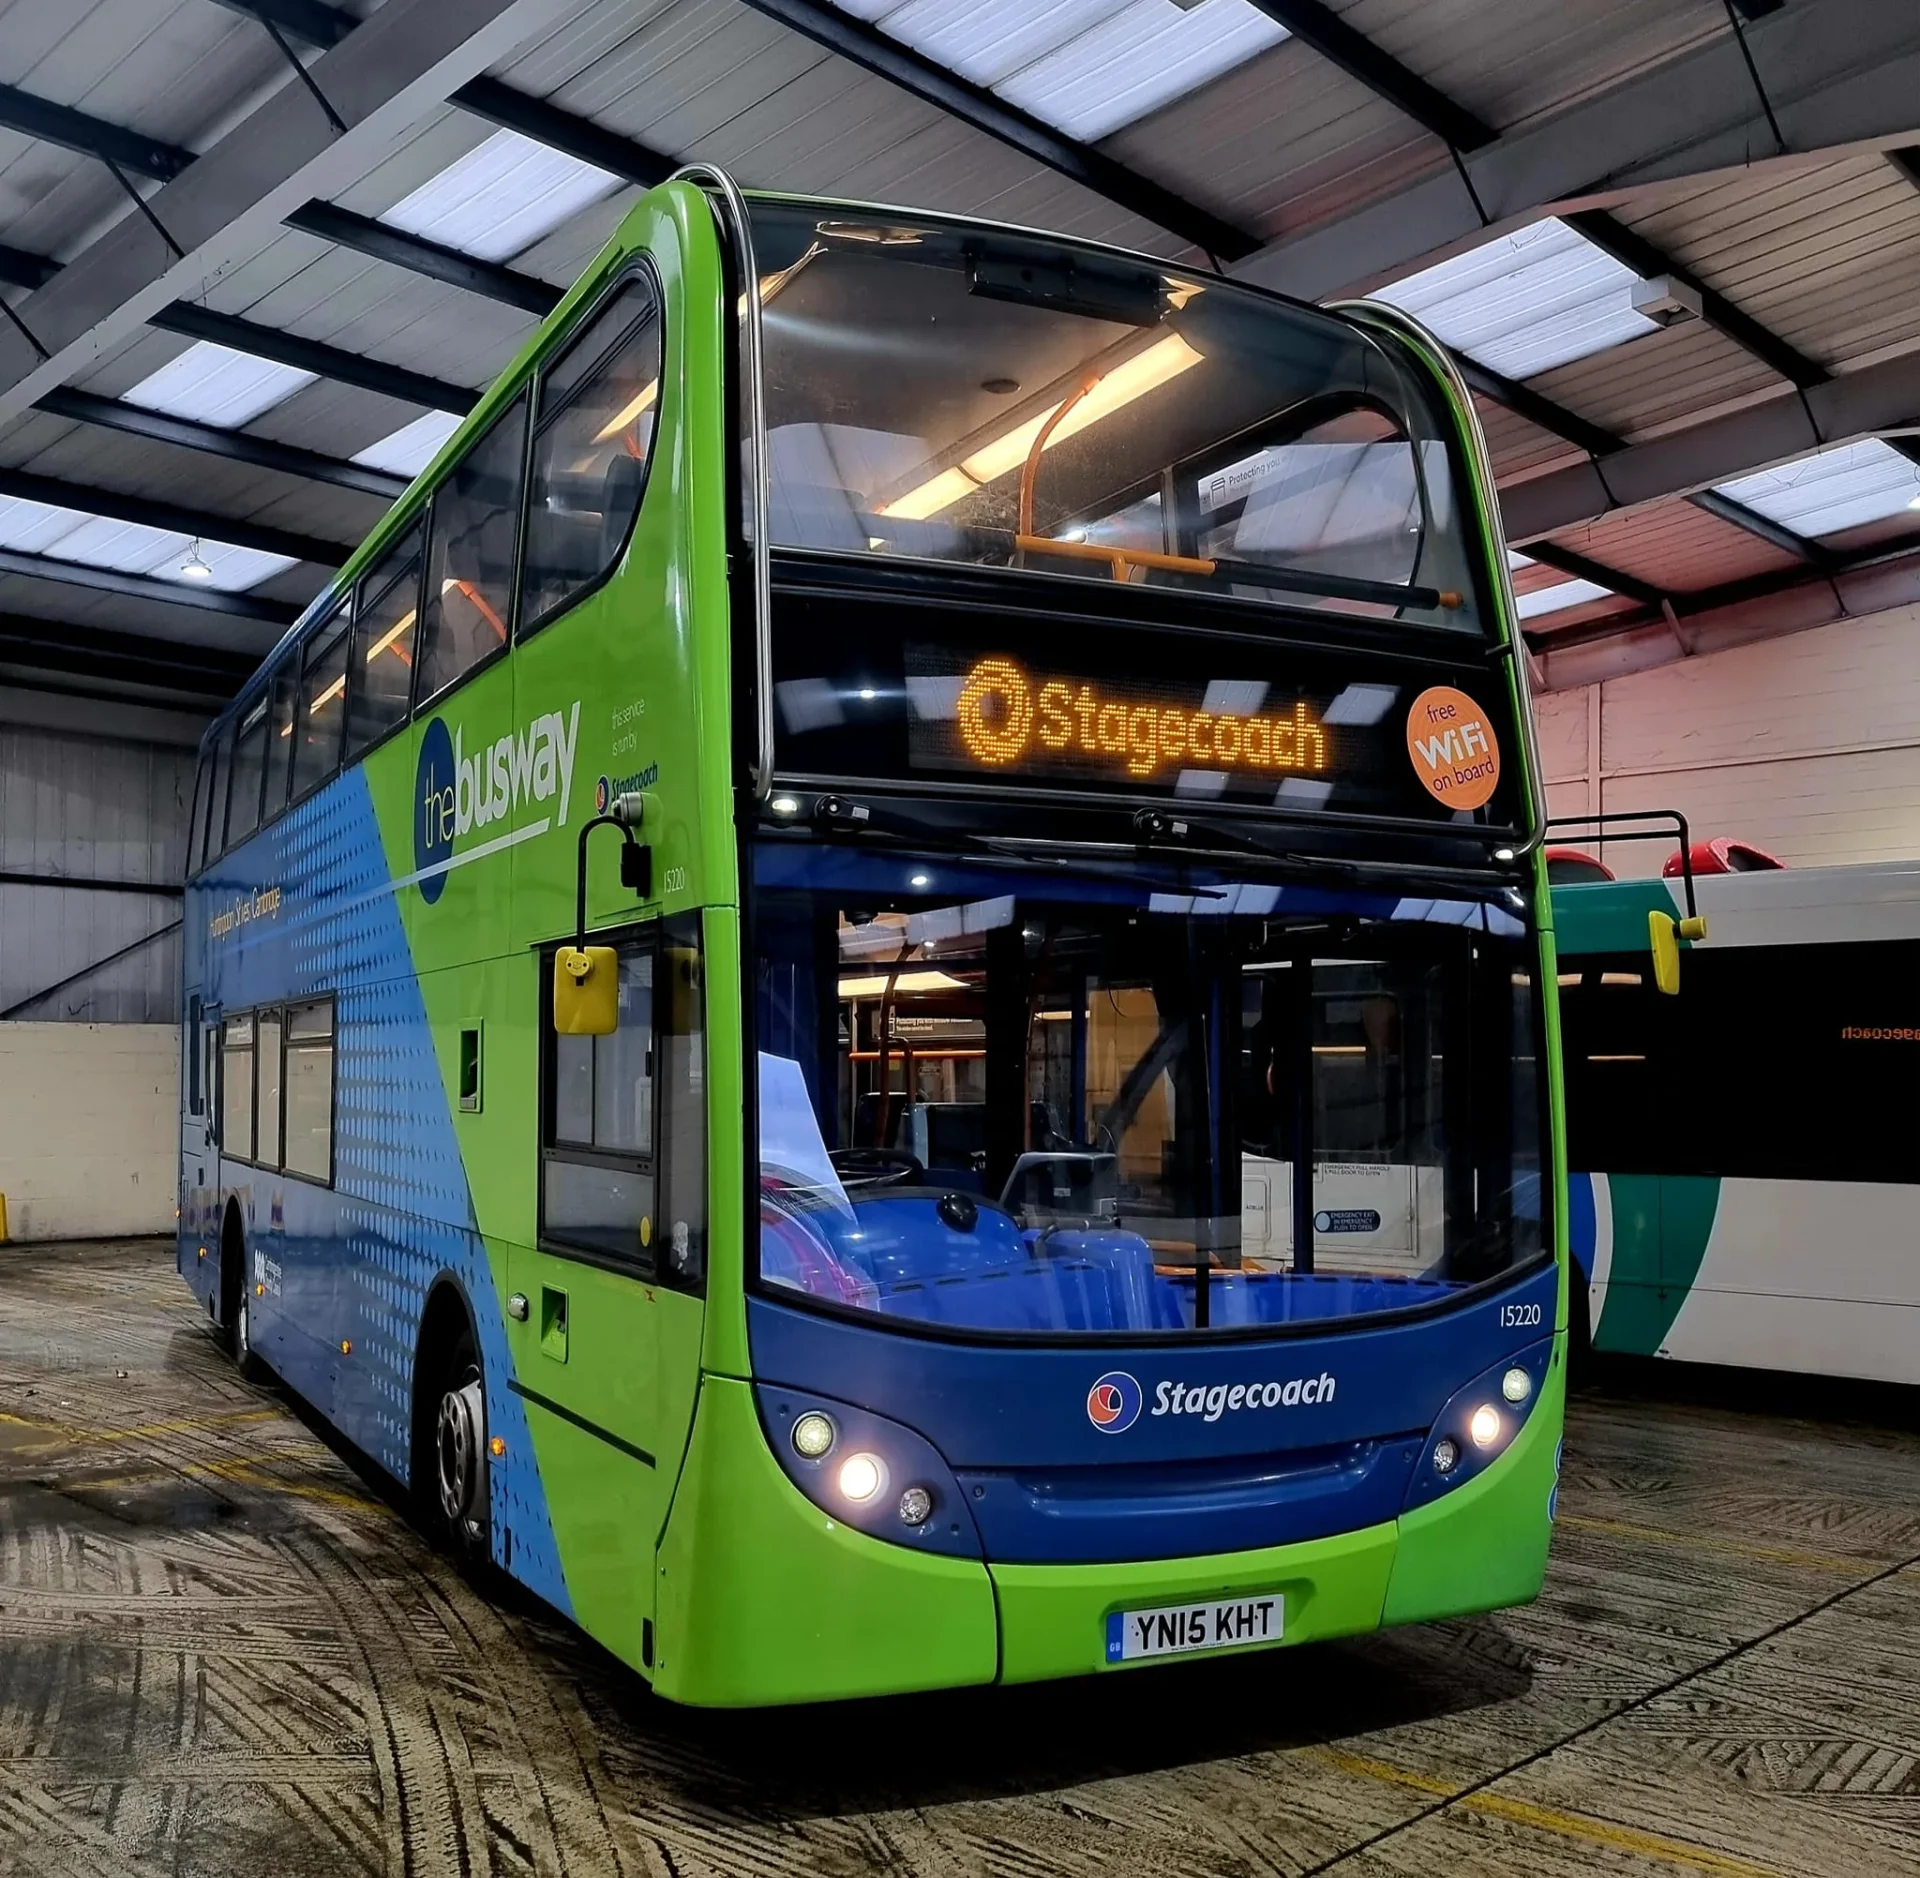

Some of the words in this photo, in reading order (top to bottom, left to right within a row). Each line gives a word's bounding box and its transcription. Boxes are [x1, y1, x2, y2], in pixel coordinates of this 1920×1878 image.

[1229, 464, 1266, 486] Protecting
[622, 698, 645, 723] service
[1427, 704, 1457, 723] free
[1039, 682, 1324, 774] Stagecoach
[1414, 721, 1489, 770] WiFi
[1433, 775, 1453, 791] on
[1453, 755, 1495, 785] board
[664, 866, 685, 894] 15220
[1501, 1304, 1541, 1328] 15220
[1151, 1372, 1336, 1422] Stagecoach
[1137, 1611, 1206, 1651] YN15
[1216, 1601, 1274, 1641] KHT
[1110, 1642, 1121, 1652] GB
